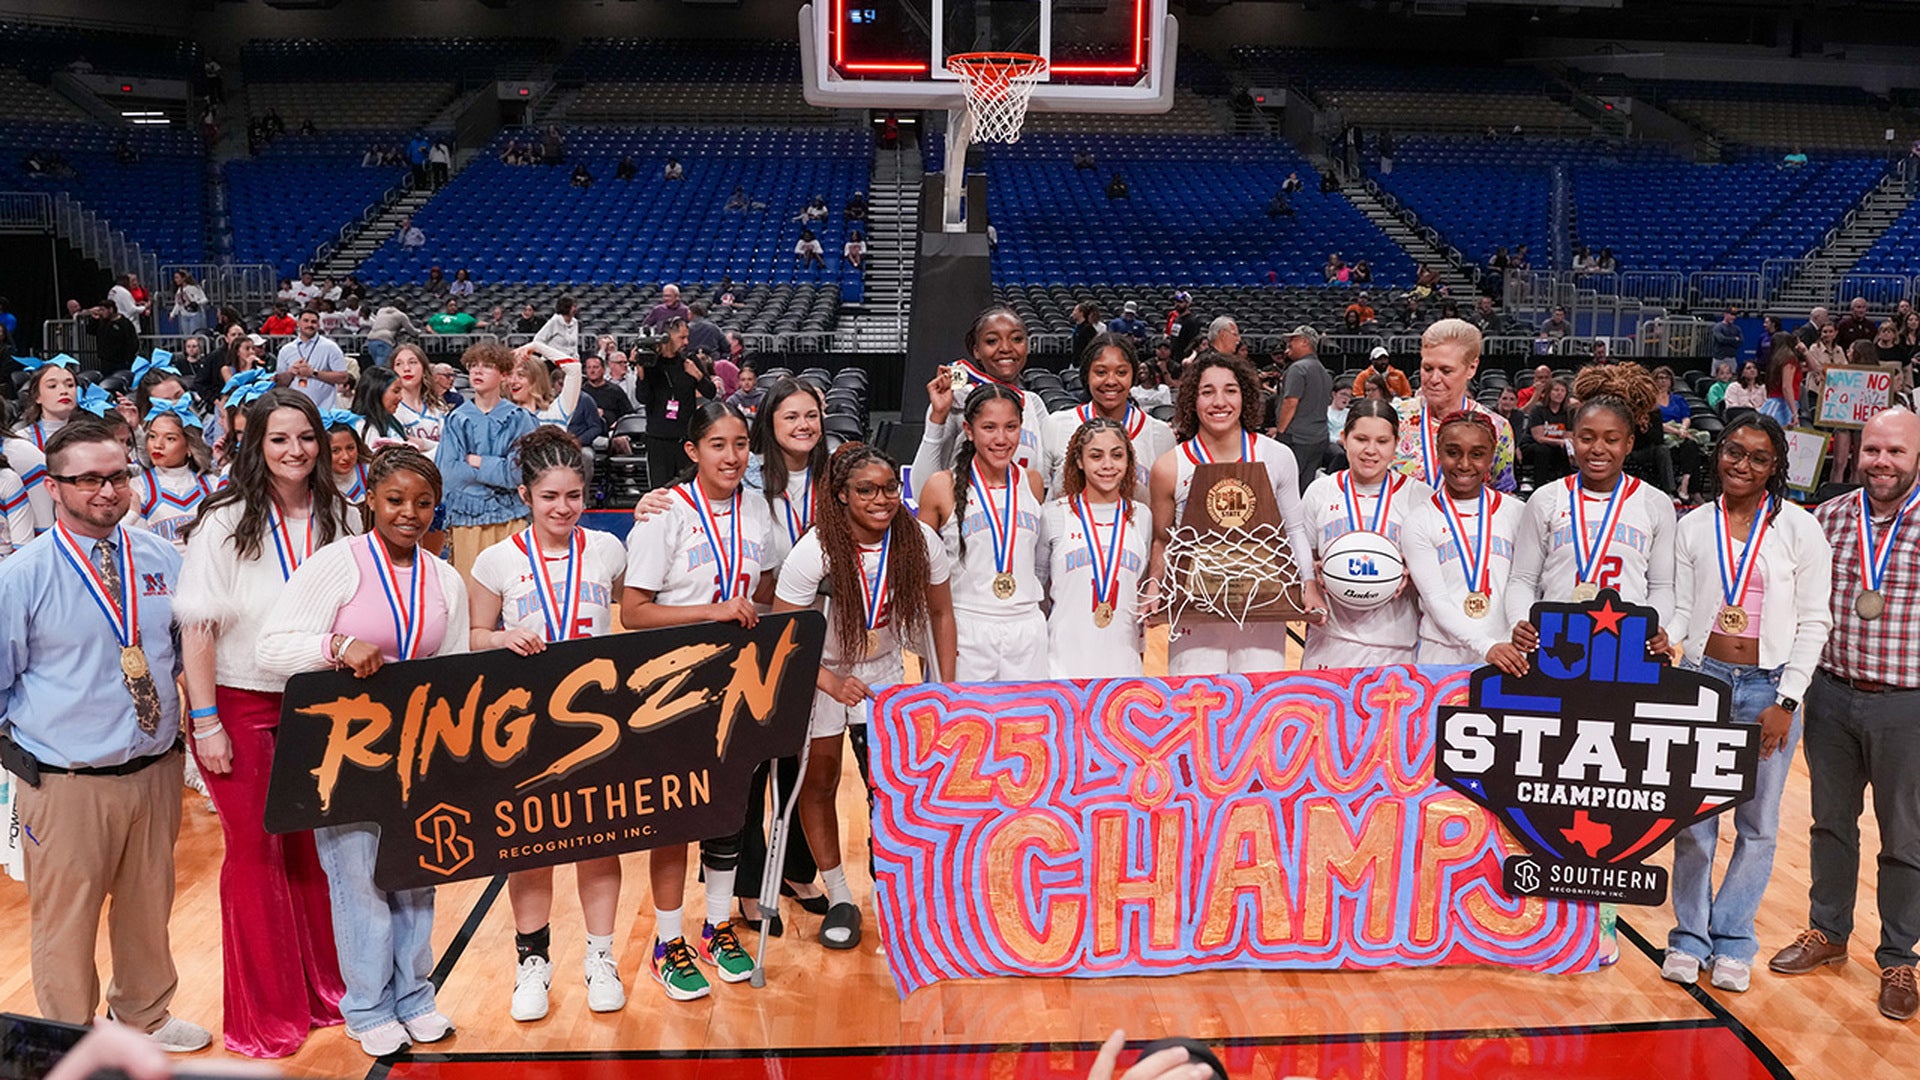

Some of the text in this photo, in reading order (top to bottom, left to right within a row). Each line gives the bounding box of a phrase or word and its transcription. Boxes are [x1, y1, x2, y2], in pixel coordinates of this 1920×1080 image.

[1826, 371, 1891, 391] HAVE NO
[1823, 403, 1888, 422] IS HER
[295, 617, 799, 811] RING SZN
[1103, 675, 1470, 808] Stat
[1443, 711, 1748, 791] STATE
[494, 769, 711, 838] SOUTHERN
[1517, 781, 1667, 812] CHAMPIONS
[499, 824, 658, 860] RECOGNITION INC.
[1550, 864, 1657, 890] SOUTHERN
[1550, 886, 1607, 897] RECOGNITION
